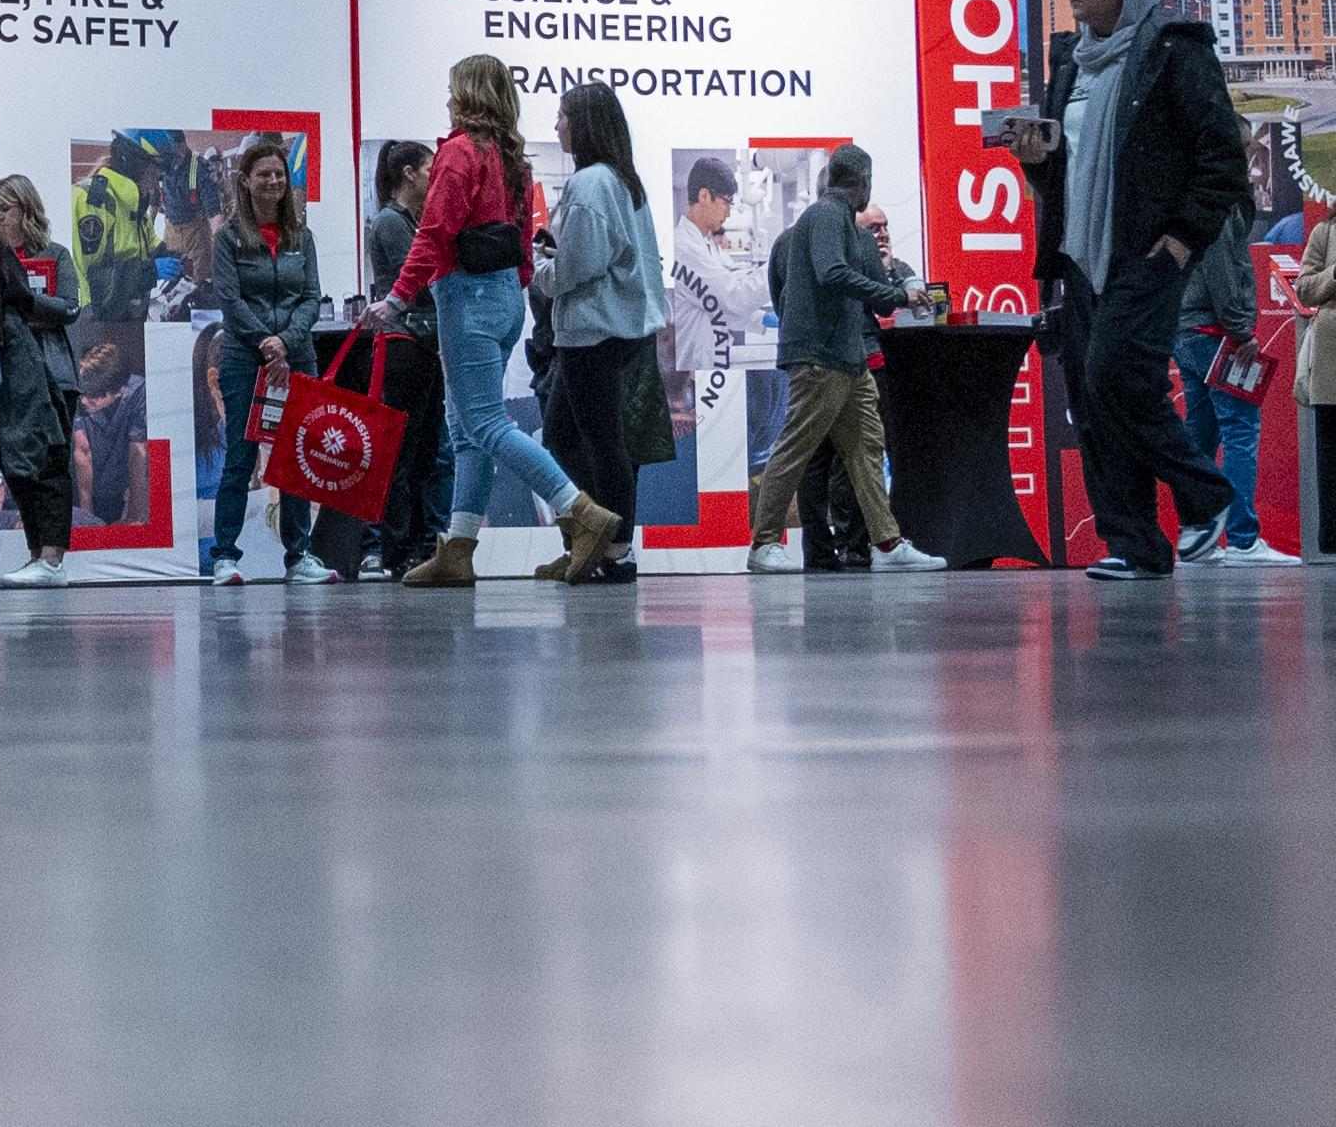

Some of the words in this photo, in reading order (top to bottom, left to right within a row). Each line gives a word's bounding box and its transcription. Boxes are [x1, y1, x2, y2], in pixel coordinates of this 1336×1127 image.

[34, 15, 178, 47] SAFETY
[485, 11, 731, 42] ENGINEERING
[958, 166, 1024, 252] IS
[670, 260, 731, 409] INNOVATION
